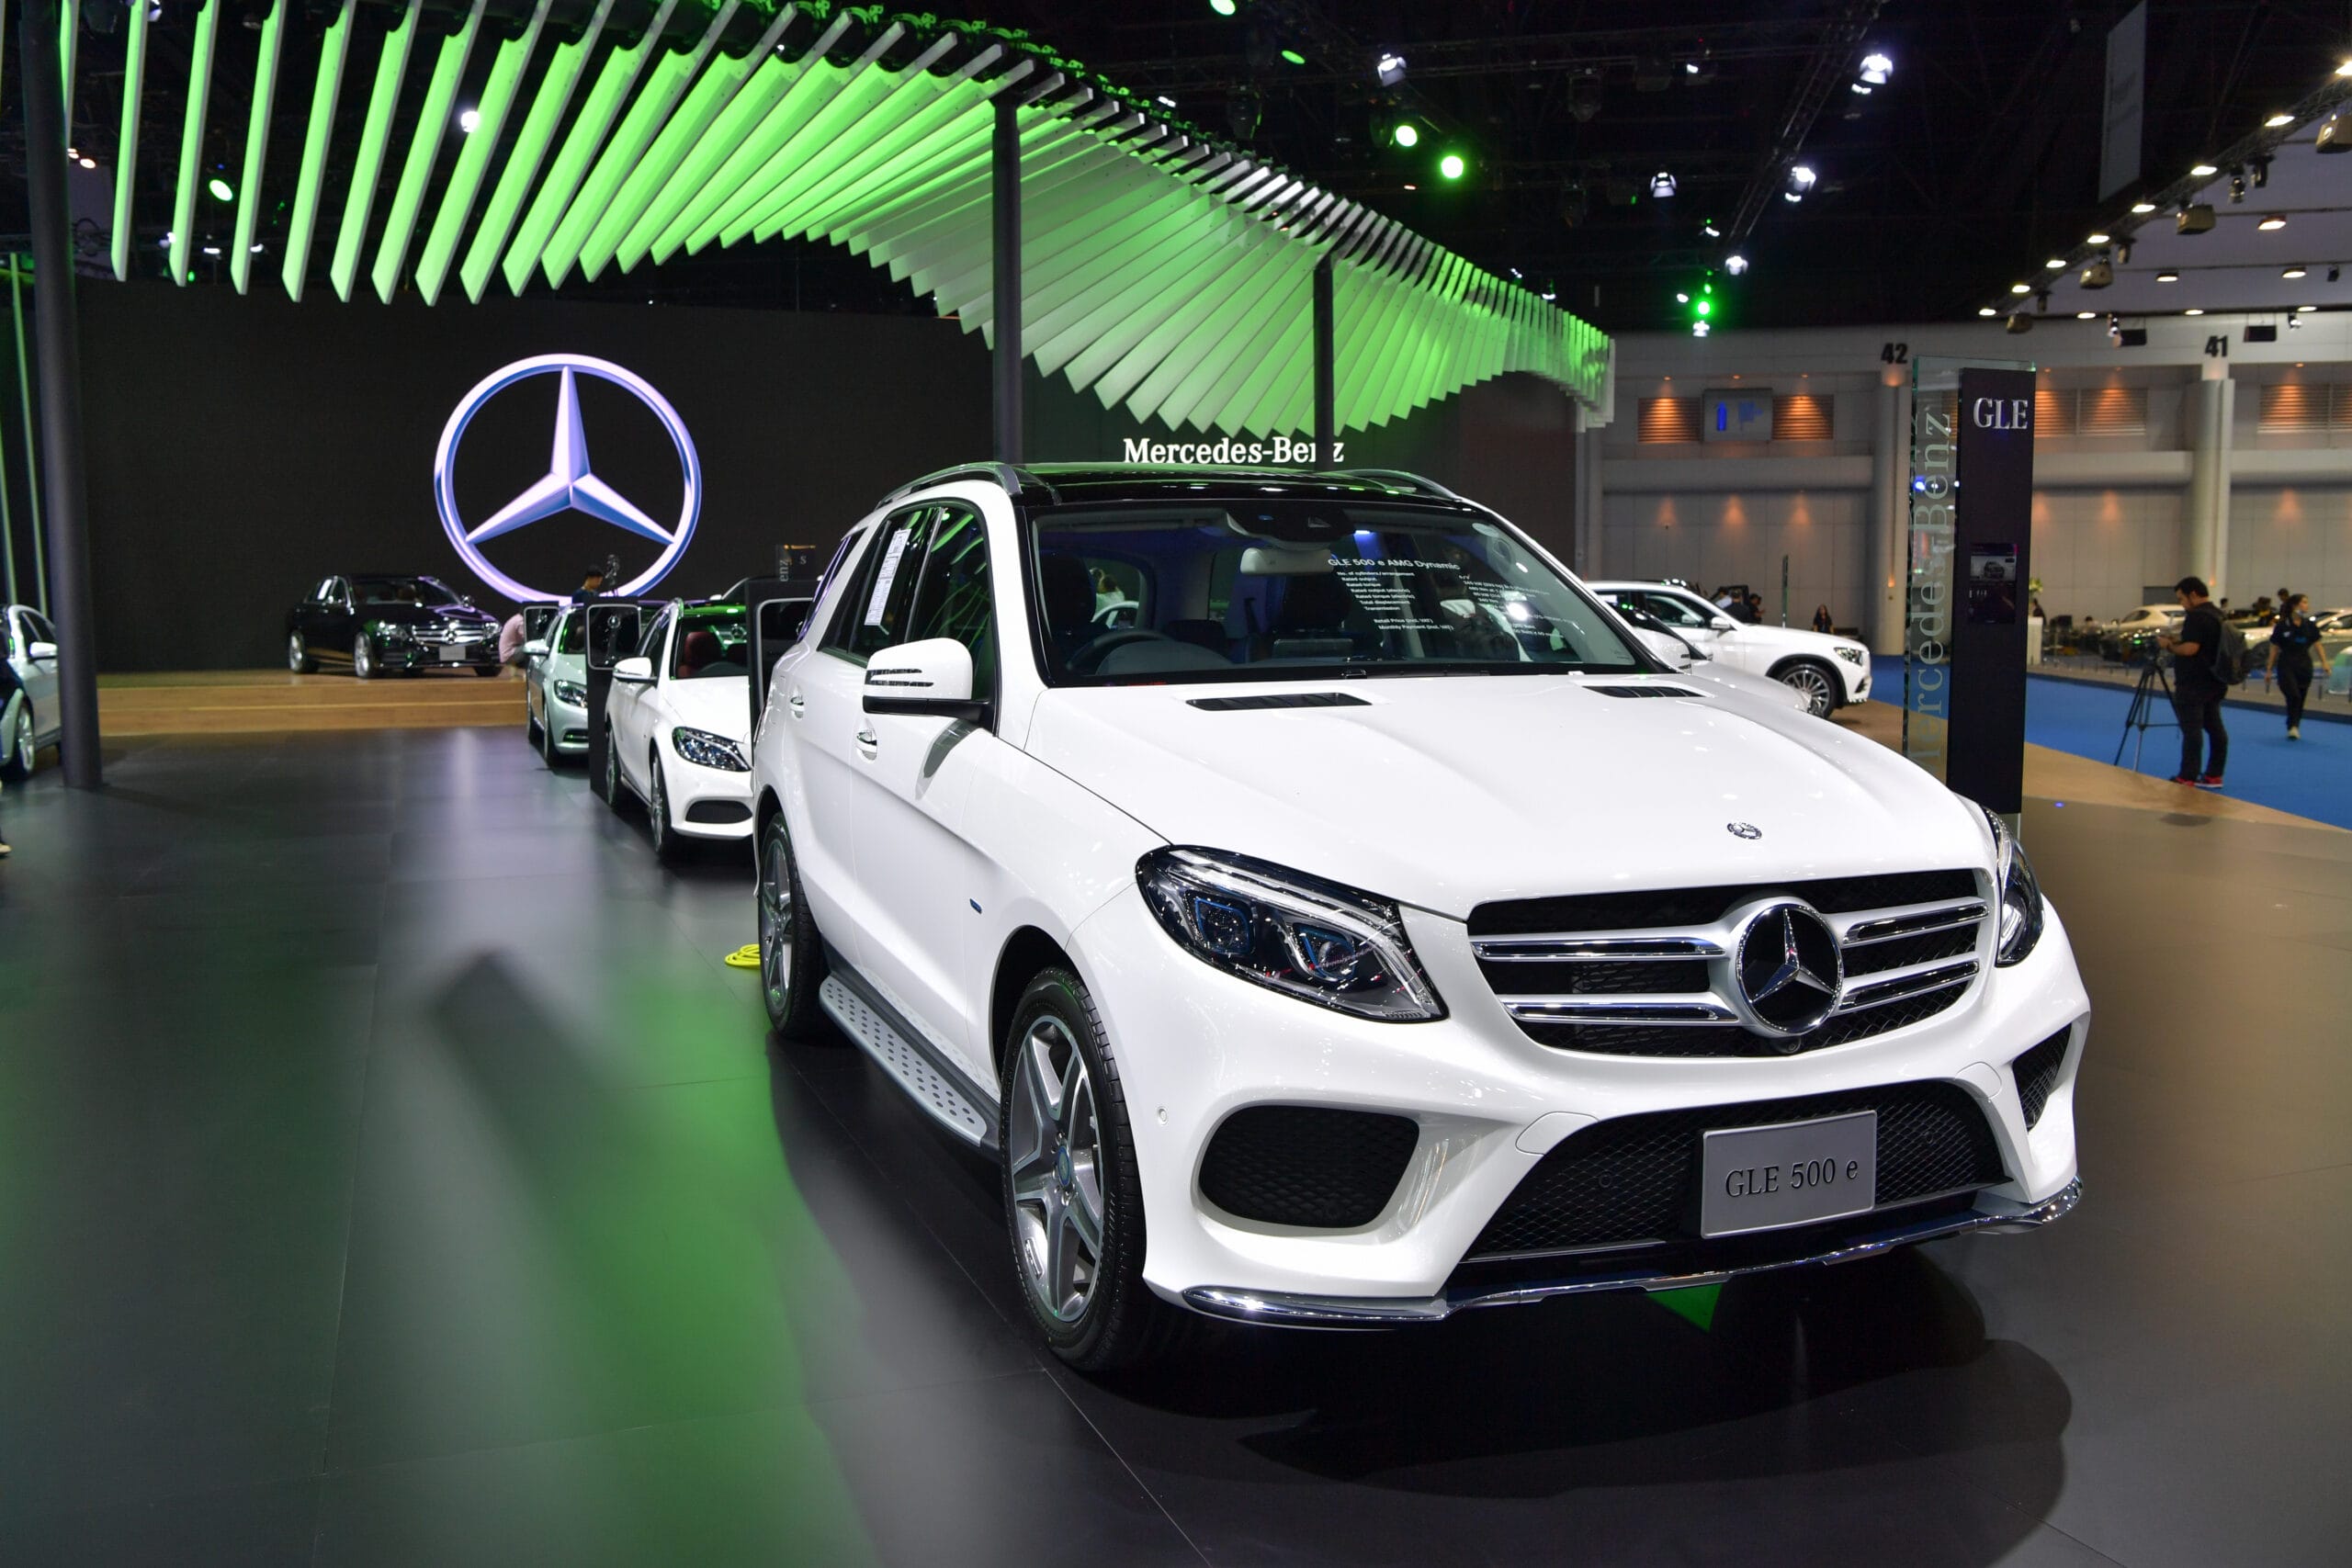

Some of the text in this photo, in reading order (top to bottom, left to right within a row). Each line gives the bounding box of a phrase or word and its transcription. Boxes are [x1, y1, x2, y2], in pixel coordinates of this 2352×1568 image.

[1881, 343, 1908, 364] 42
[2205, 335, 2228, 357] 41
[1973, 397, 2029, 430] GLE
[1328, 558, 1351, 567] GLE
[1387, 558, 1414, 568] AMG
[1414, 560, 1461, 570] Dynamic
[1724, 1156, 1859, 1198] GLE 500 e
